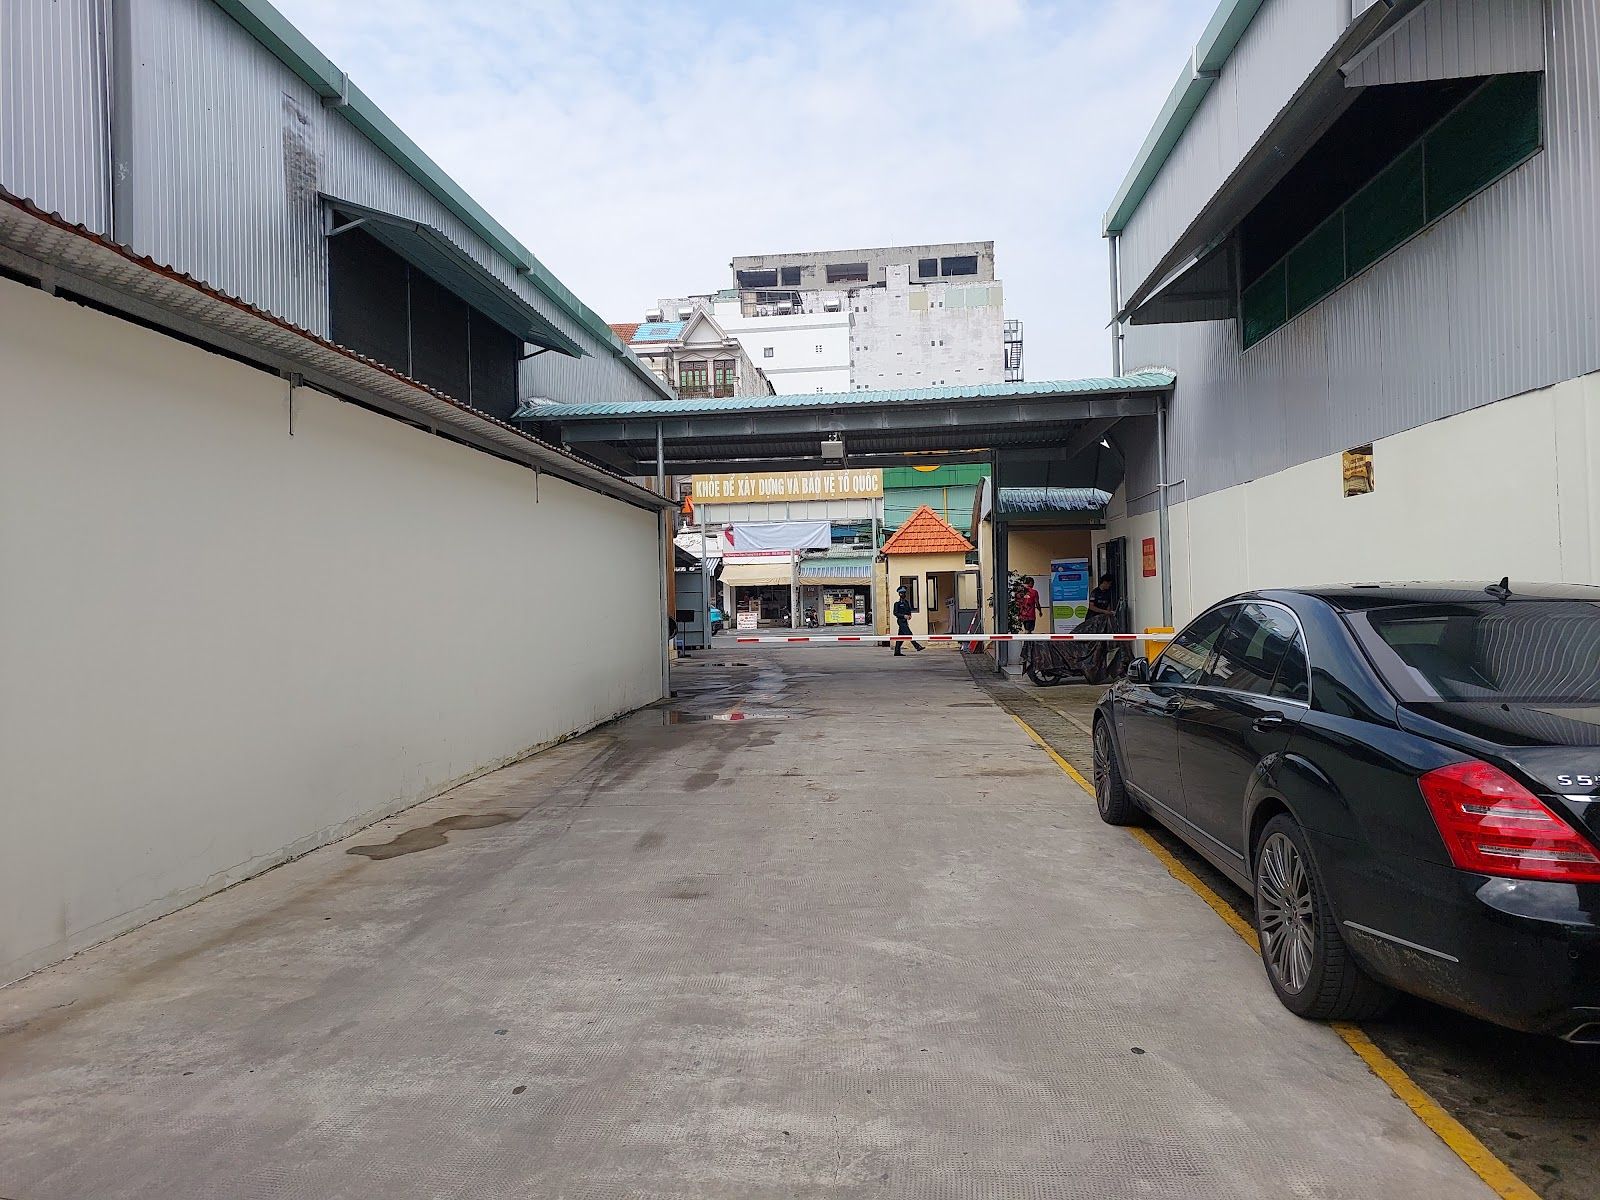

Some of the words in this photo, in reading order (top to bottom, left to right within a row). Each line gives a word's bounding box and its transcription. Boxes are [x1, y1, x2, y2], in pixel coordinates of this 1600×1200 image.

[696, 474, 720, 498] KHỎE
[738, 475, 755, 497] XÂY
[758, 477, 784, 499] DỰNG
[787, 474, 800, 495] VÀ
[801, 472, 821, 494] BẢO
[824, 472, 836, 497] VỆ
